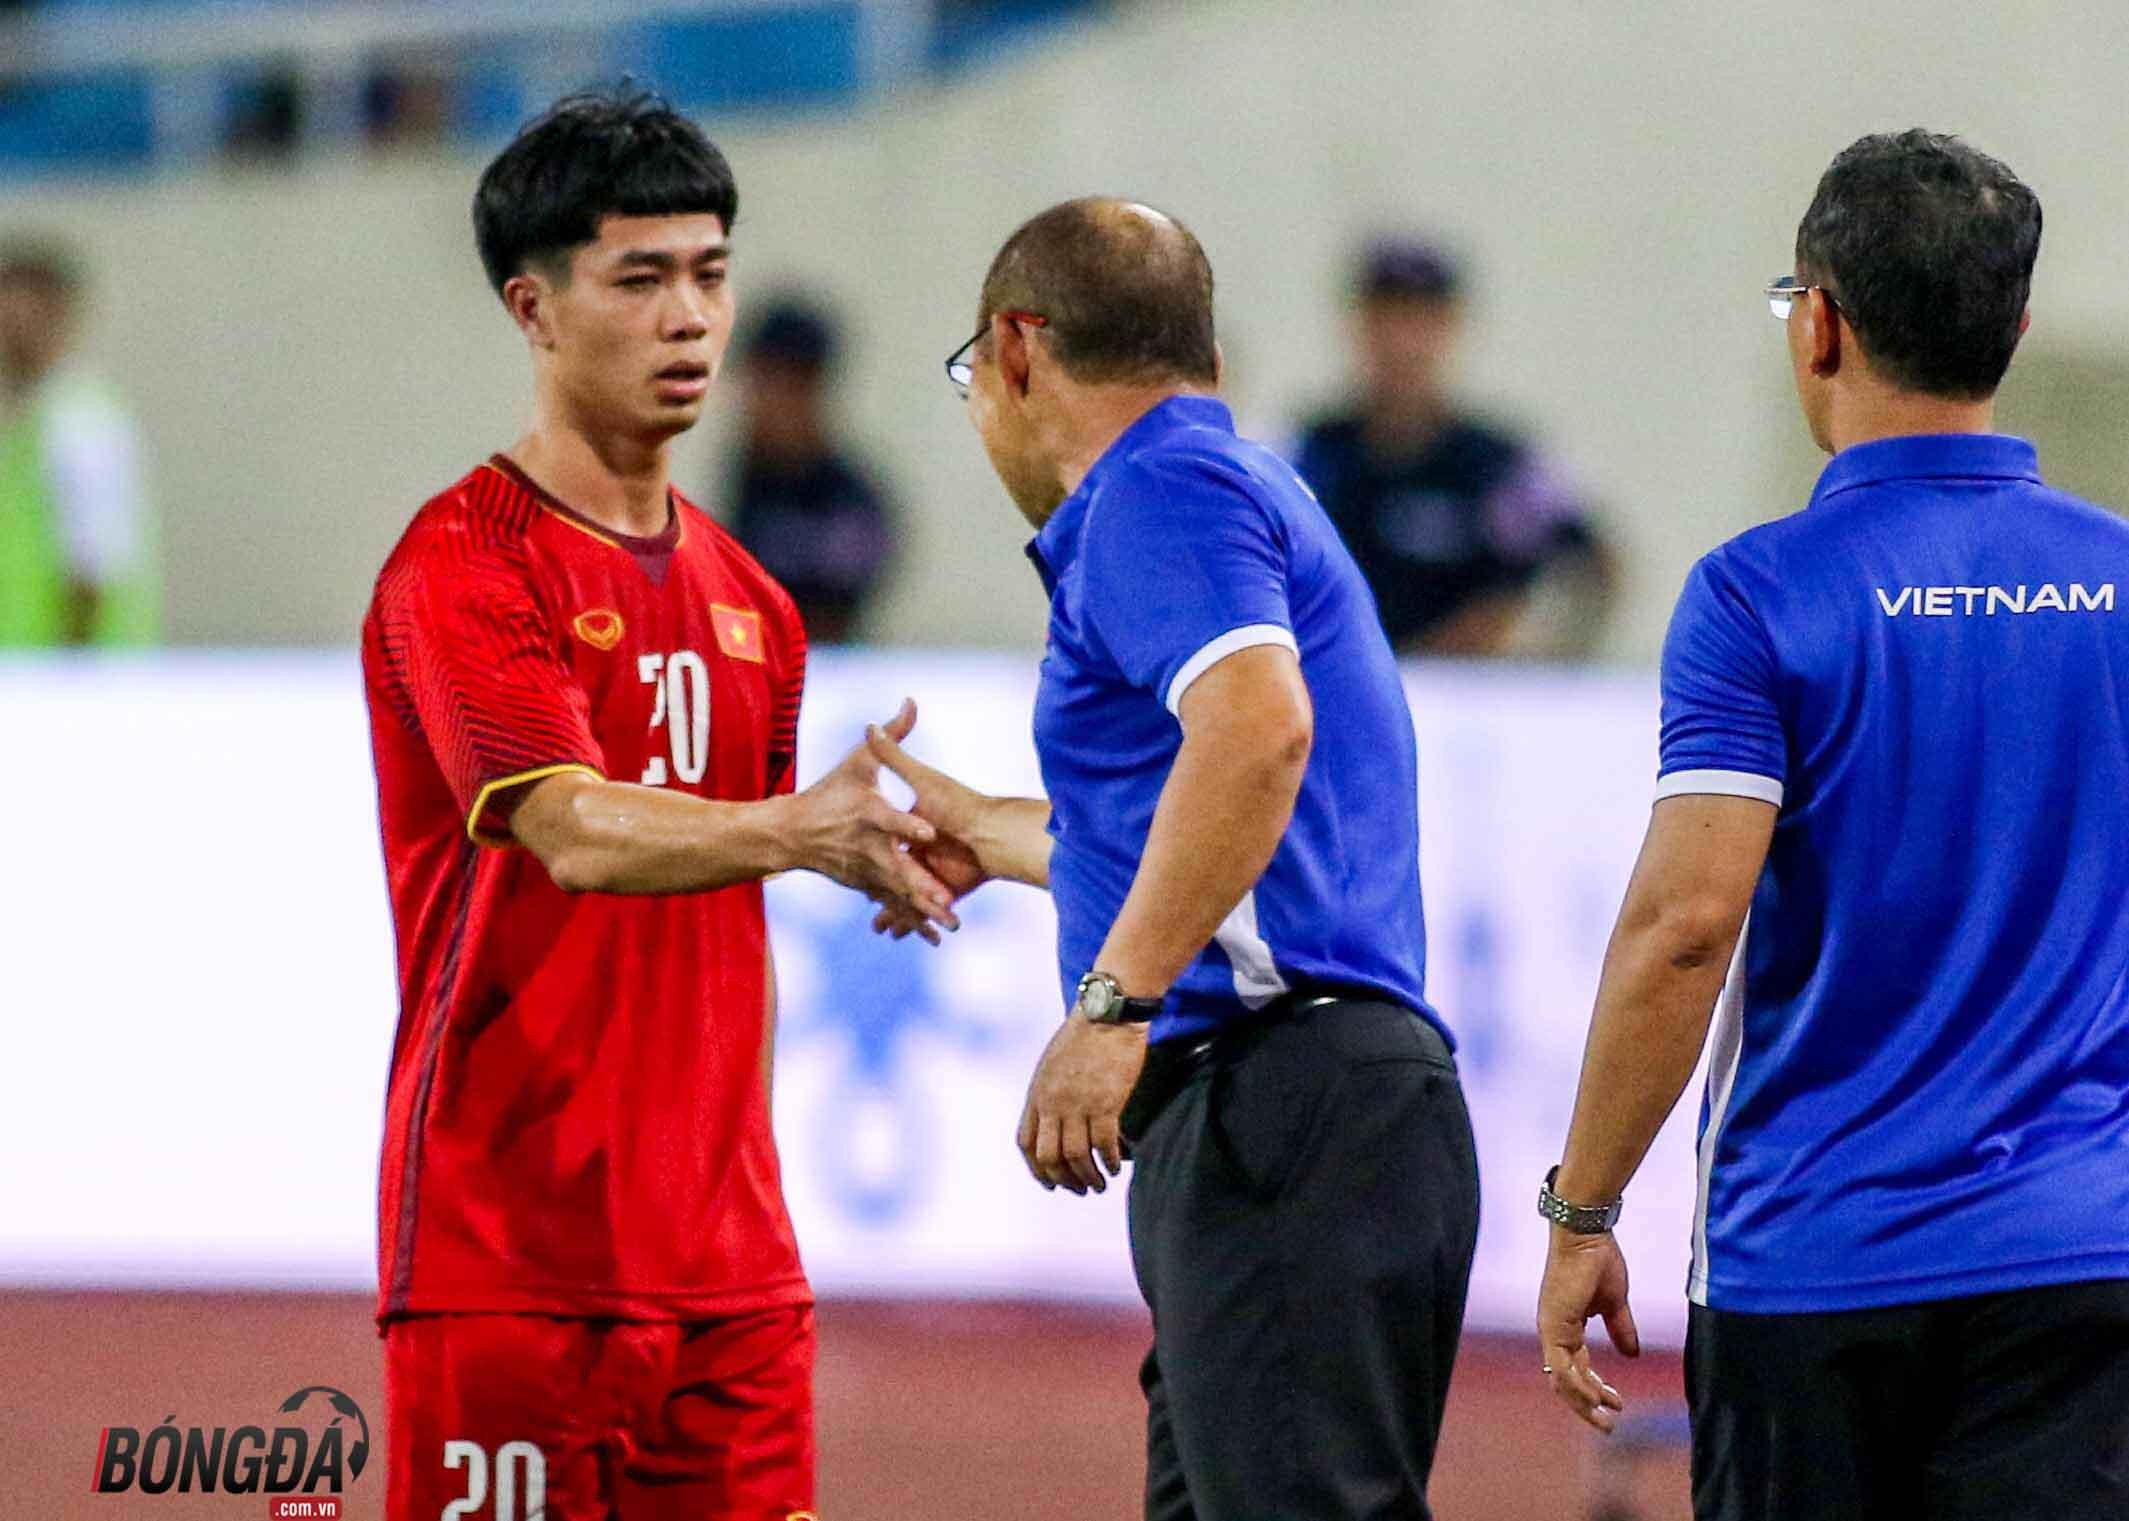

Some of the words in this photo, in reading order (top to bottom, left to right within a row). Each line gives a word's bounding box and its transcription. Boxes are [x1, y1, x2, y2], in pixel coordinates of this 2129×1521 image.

[1876, 583, 2115, 616] VIETNAM
[638, 650, 710, 785] 20
[441, 1440, 547, 1521] 20
